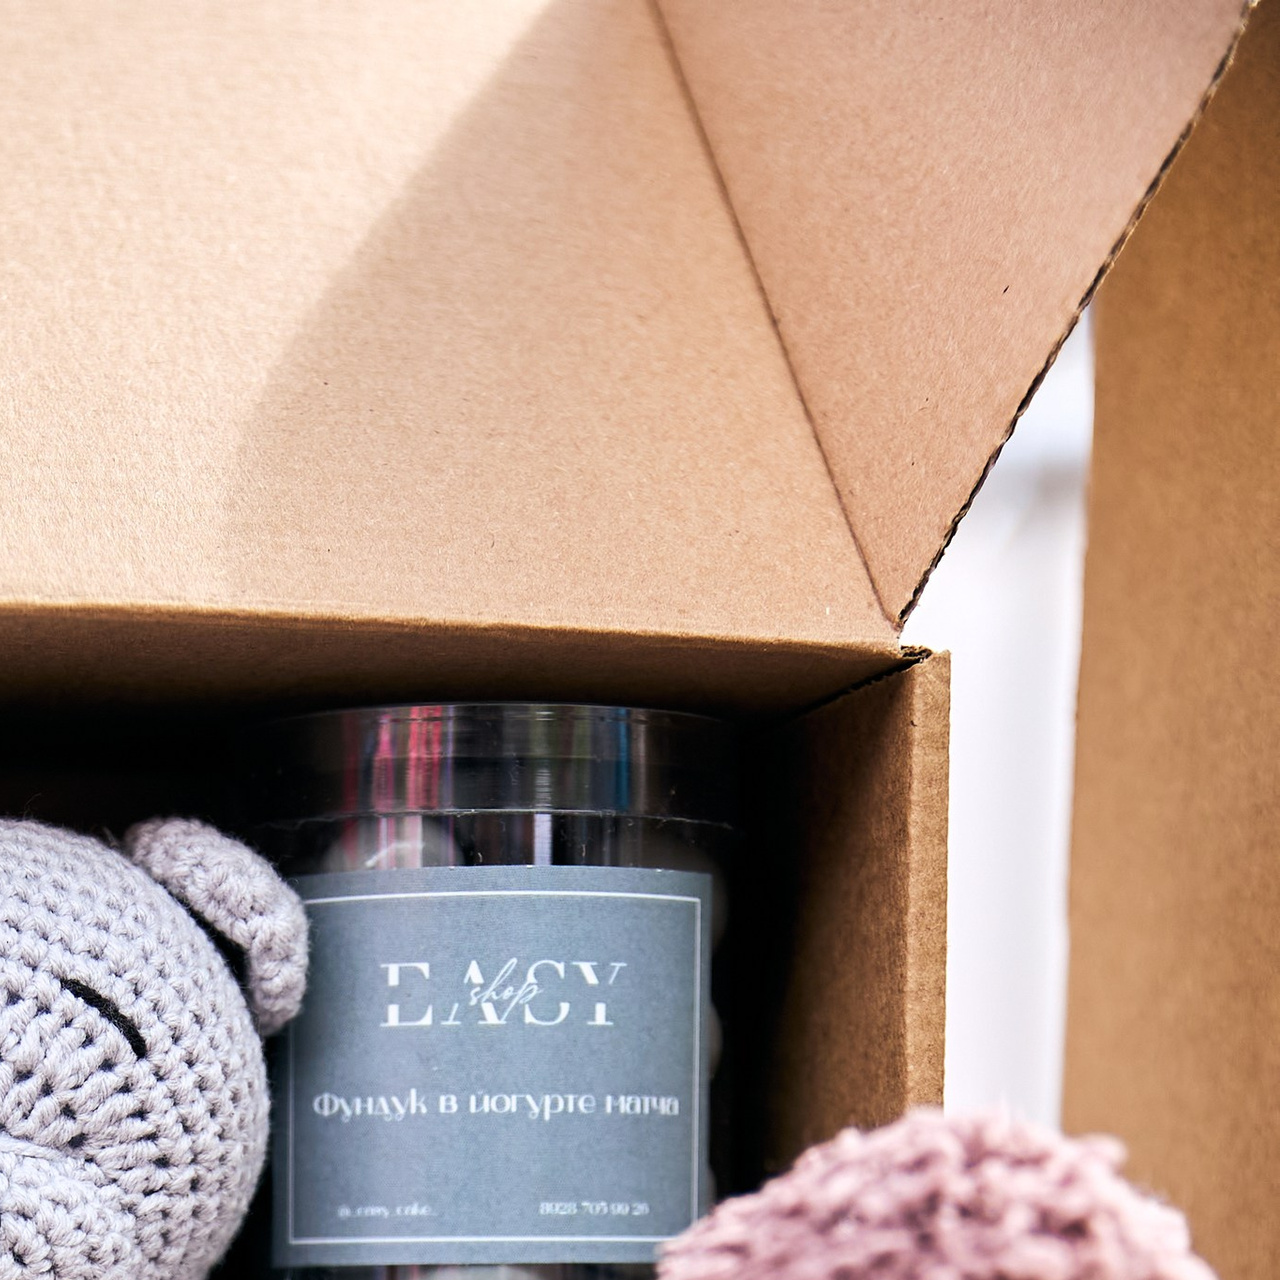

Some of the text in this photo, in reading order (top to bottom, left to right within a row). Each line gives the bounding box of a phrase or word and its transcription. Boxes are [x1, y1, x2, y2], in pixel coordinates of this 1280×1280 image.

[380, 959, 628, 1027] EASY
[469, 957, 545, 1024] shop
[313, 1088, 428, 1123] Фундук
[438, 1094, 459, 1114] в
[469, 1089, 597, 1121] йогурте
